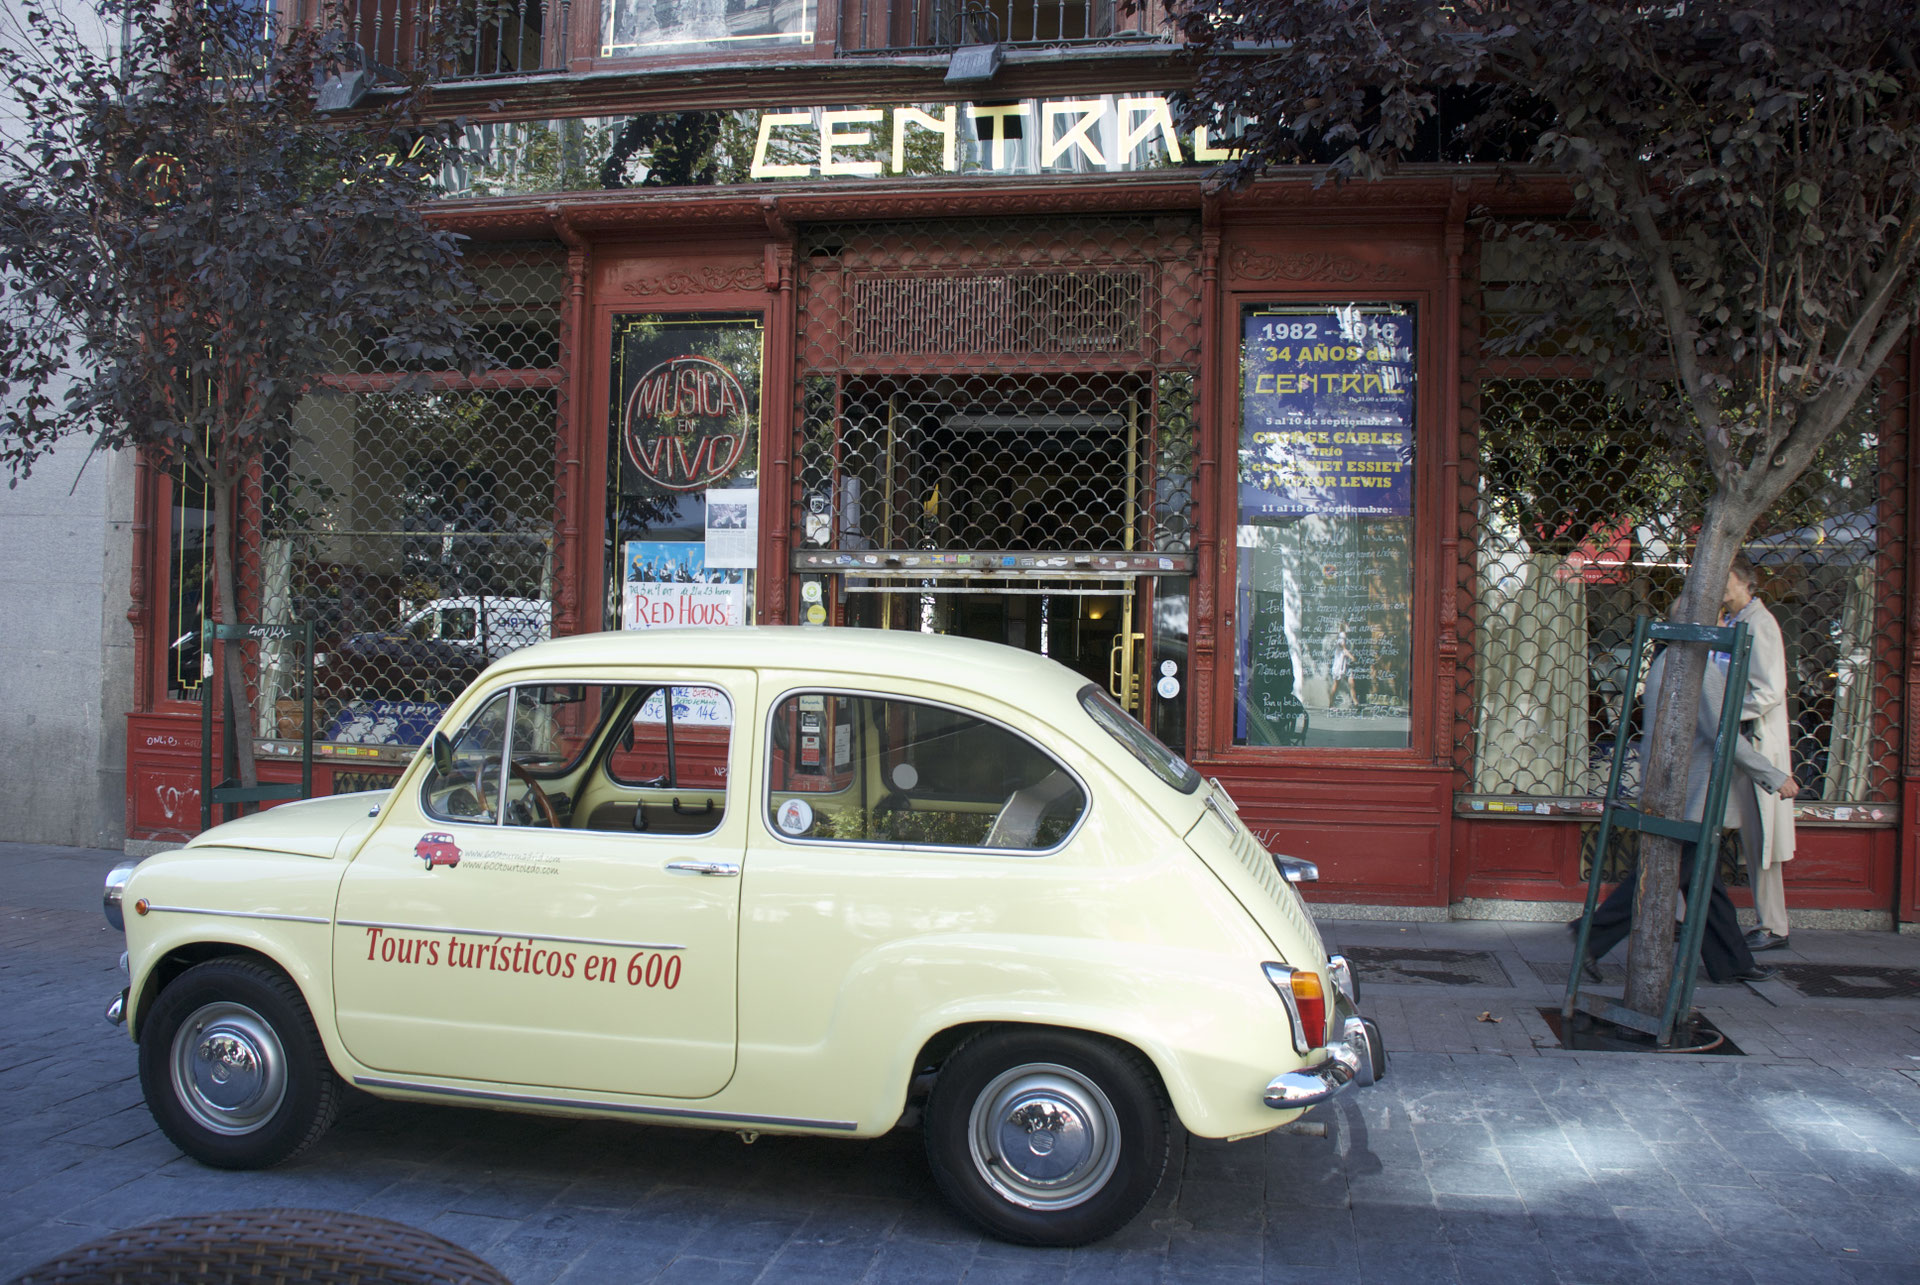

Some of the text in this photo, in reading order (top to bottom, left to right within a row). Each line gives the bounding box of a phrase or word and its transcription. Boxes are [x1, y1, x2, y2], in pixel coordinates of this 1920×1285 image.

[751, 98, 1246, 179] CENTRAL
[1262, 323, 1317, 340] 1982
[1266, 347, 1292, 361] 34
[1297, 343, 1358, 362] AÑOS
[1255, 373, 1405, 394] CENTRAL
[677, 419, 695, 432] EN
[1266, 417, 1391, 428] 5 al 10 de septiembre:
[1252, 432, 1403, 445] GEORGE CABLES
[634, 434, 740, 480] VIVO
[1312, 446, 1343, 456] TRÍO
[1347, 461, 1403, 472] ESSIET
[1340, 477, 1392, 488] LEWIS
[1306, 505, 1320, 513] de
[1322, 505, 1392, 515] septiembre:
[463, 861, 559, 875] www.600tourtoledo.com
[366, 927, 682, 990] Tours turísticos en 600
